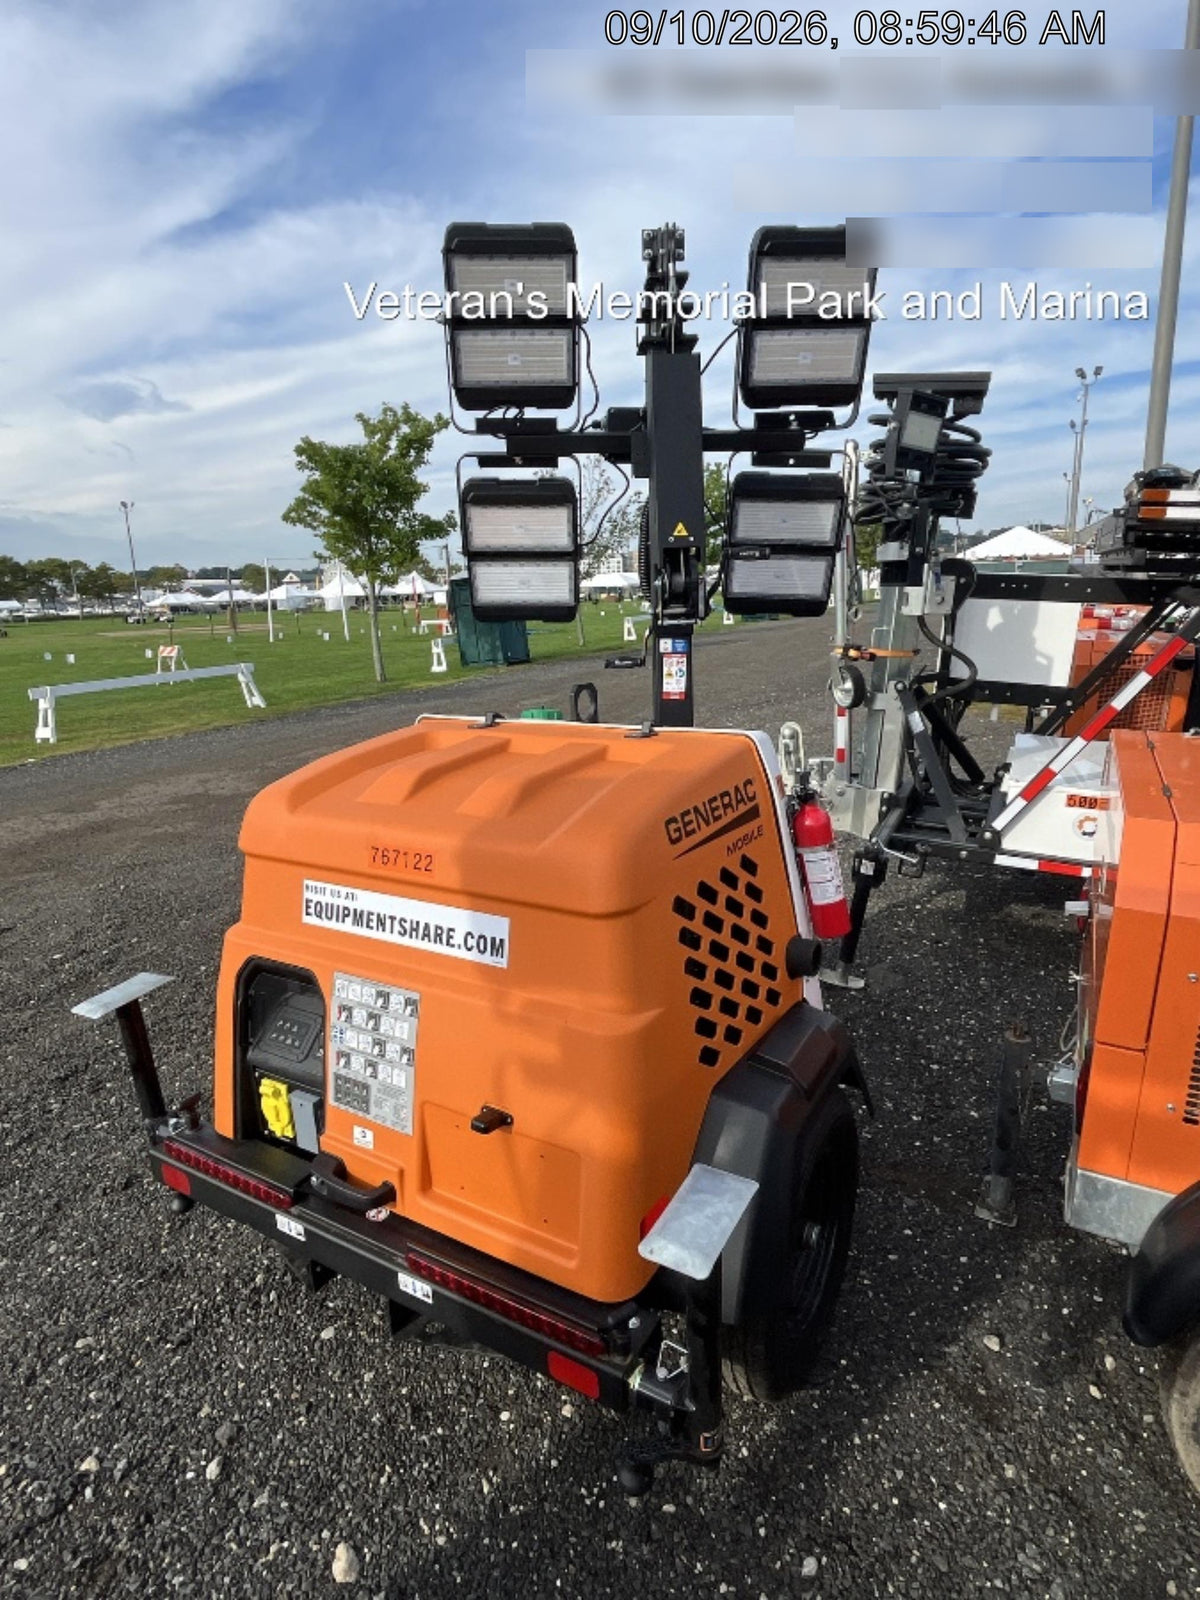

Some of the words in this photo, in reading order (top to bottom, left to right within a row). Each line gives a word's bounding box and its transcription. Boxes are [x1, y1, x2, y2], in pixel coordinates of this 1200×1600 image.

[664, 778, 757, 846] GENERAC
[726, 824, 764, 857] MOBILE
[371, 846, 433, 872] 767122
[330, 888, 342, 899] US
[304, 898, 505, 959] EQUIPMENTSHARE.COM
